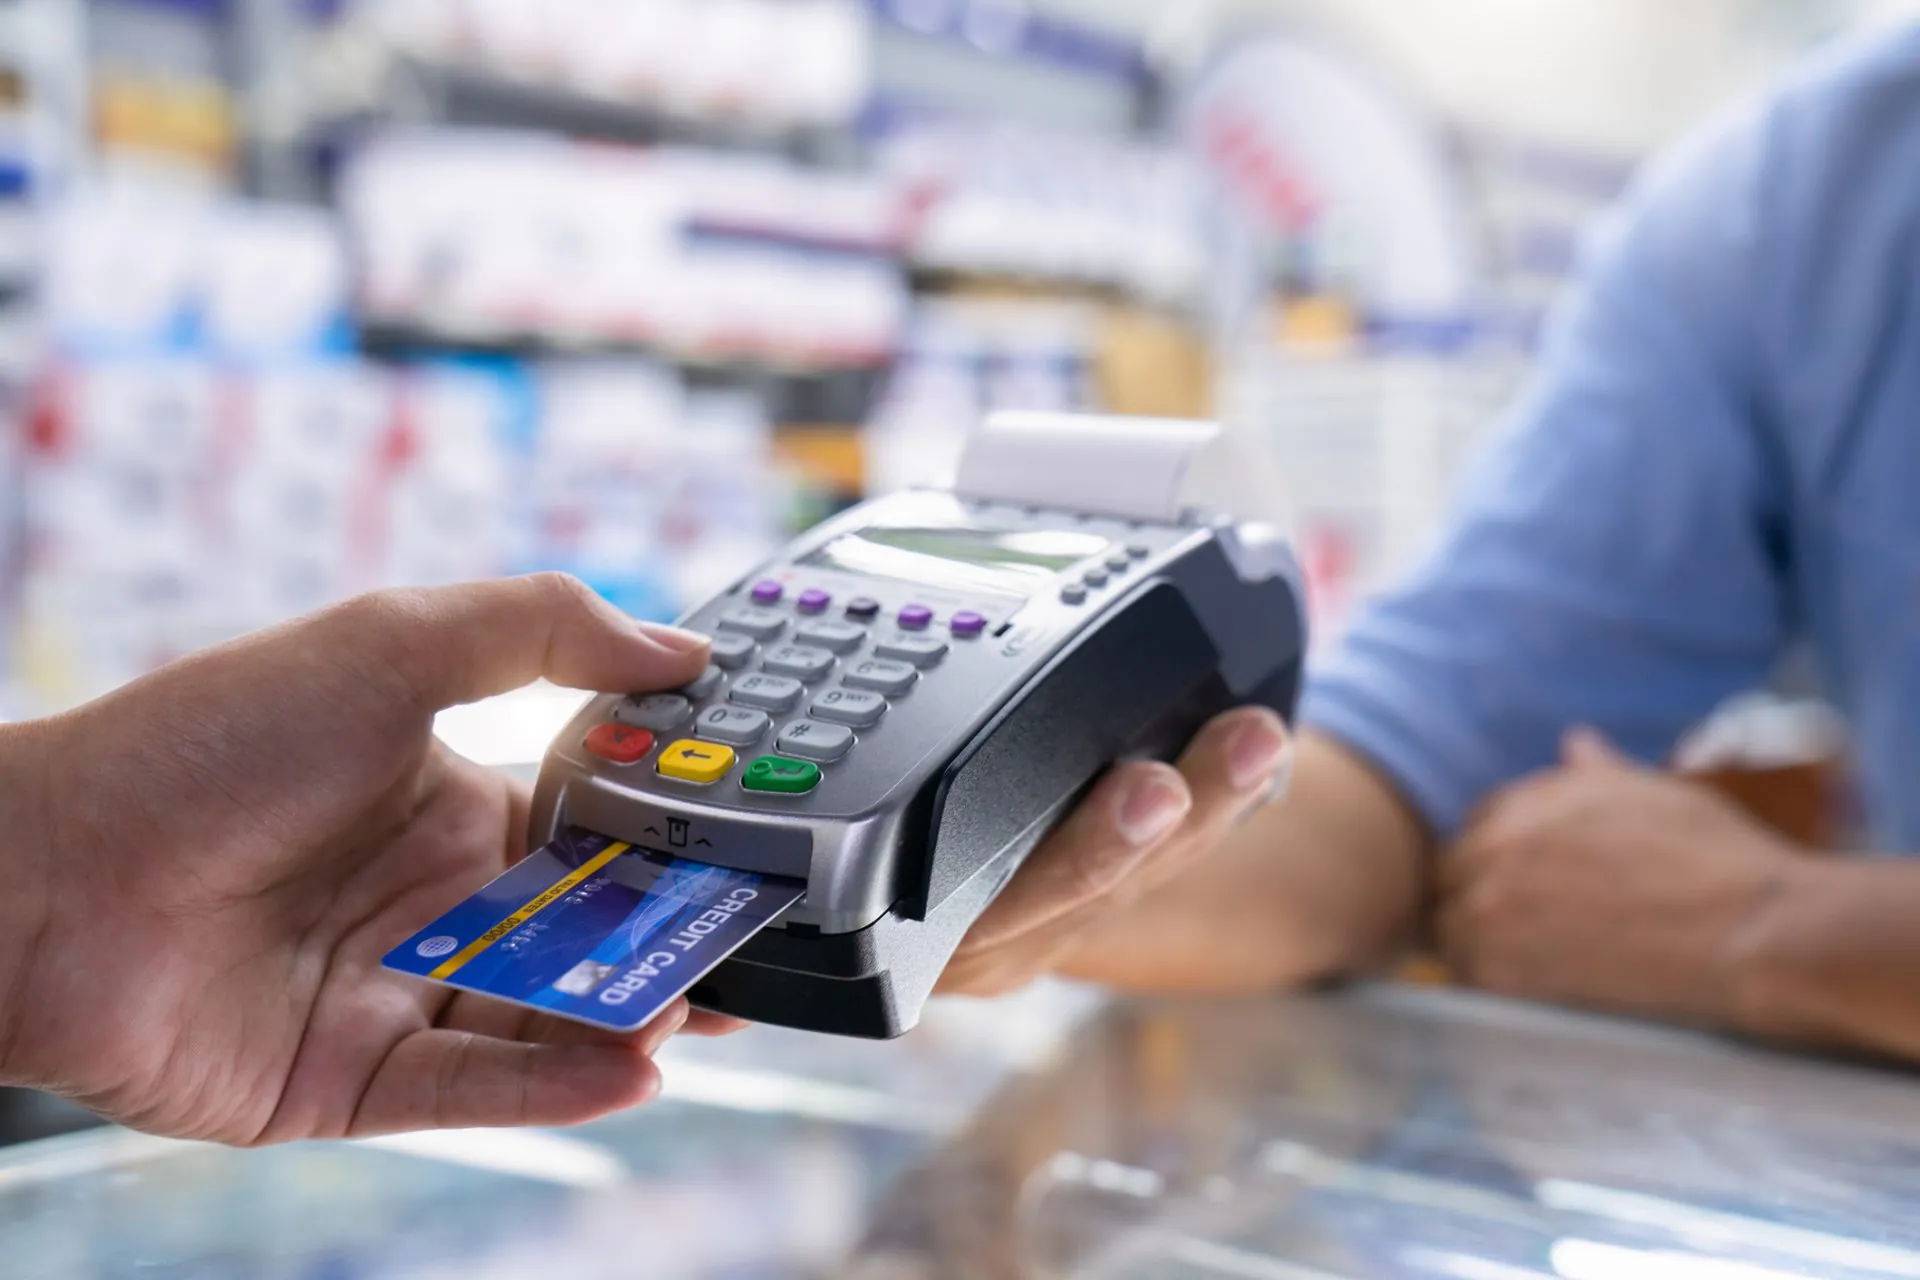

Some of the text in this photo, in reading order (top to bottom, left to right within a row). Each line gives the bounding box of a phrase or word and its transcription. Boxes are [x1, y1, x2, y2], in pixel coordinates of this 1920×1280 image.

[742, 676, 762, 689] 8
[823, 691, 842, 704] 9
[708, 709, 727, 723] 0
[789, 723, 810, 738] #
[549, 878, 579, 895] VALID
[522, 894, 554, 913] DATES
[599, 887, 758, 1006] CREDIT CARD
